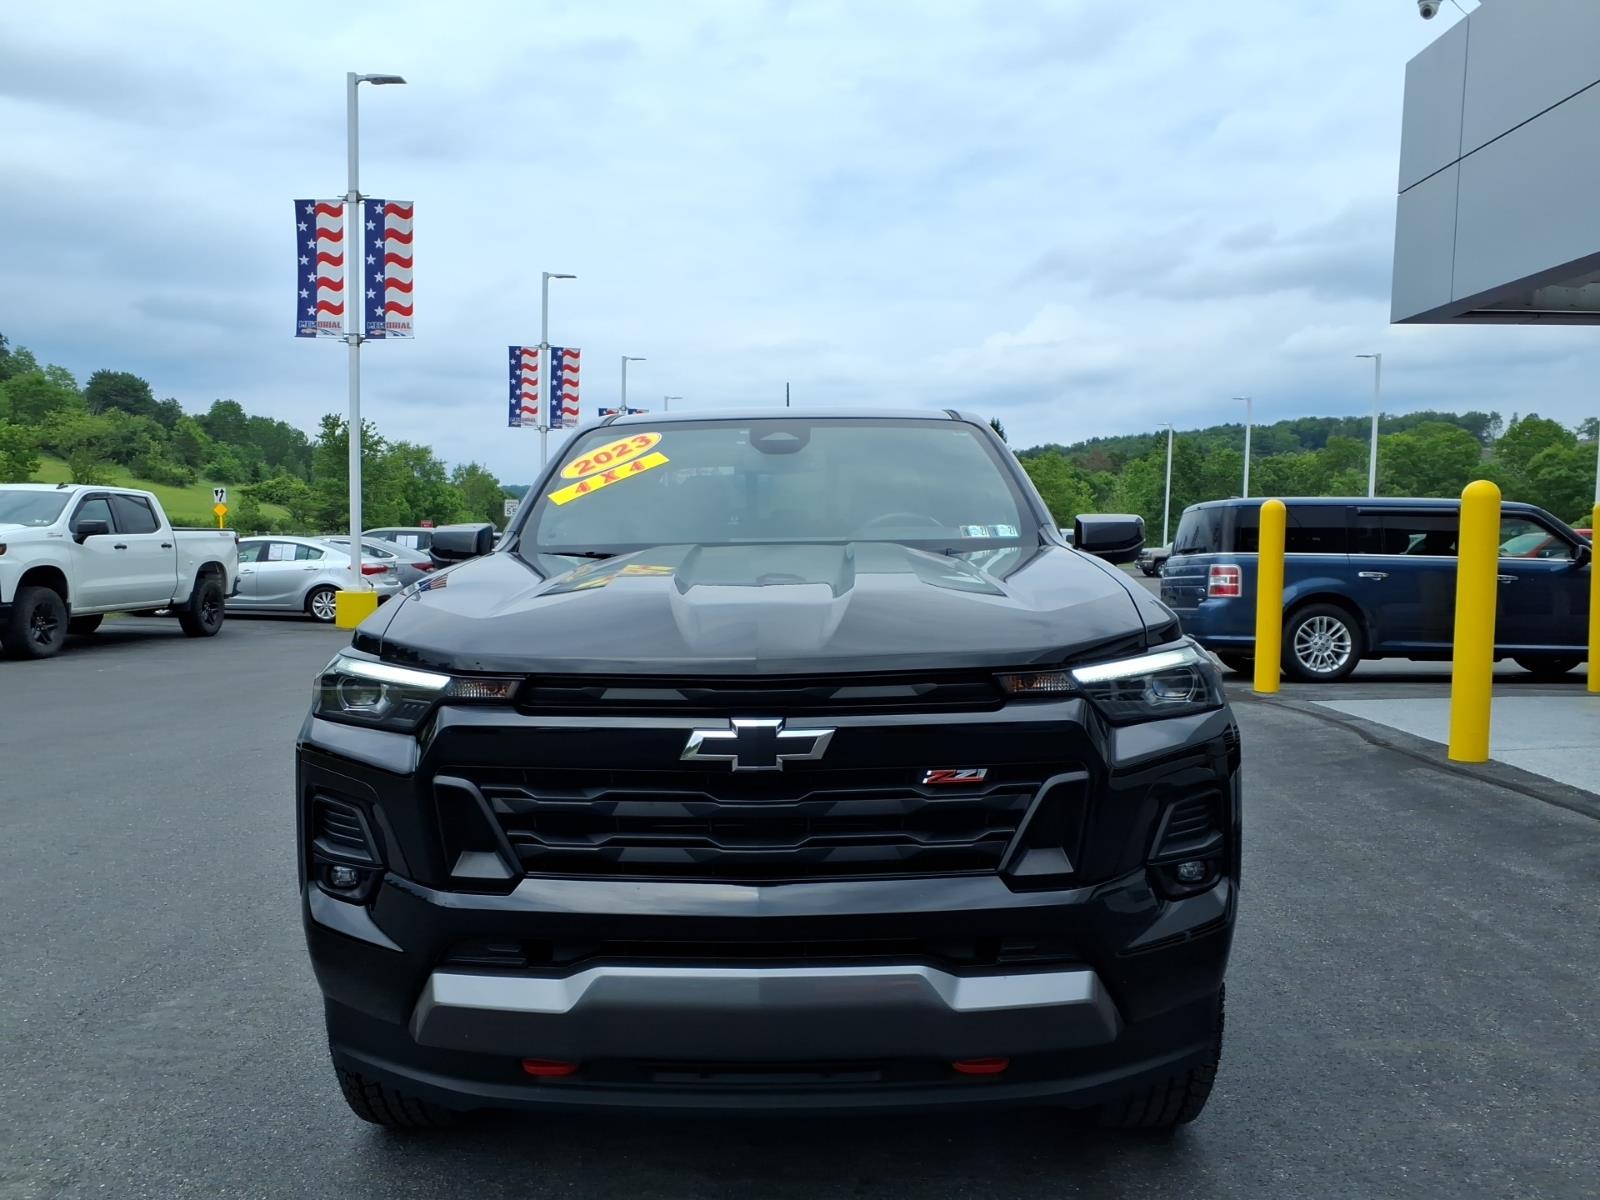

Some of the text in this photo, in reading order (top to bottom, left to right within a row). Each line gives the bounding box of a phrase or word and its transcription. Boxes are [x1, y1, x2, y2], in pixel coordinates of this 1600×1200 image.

[298, 320, 343, 329] MEMORIAL
[366, 321, 412, 330] MEMORIAL
[574, 435, 652, 476] 2023
[922, 768, 988, 785] Z71
